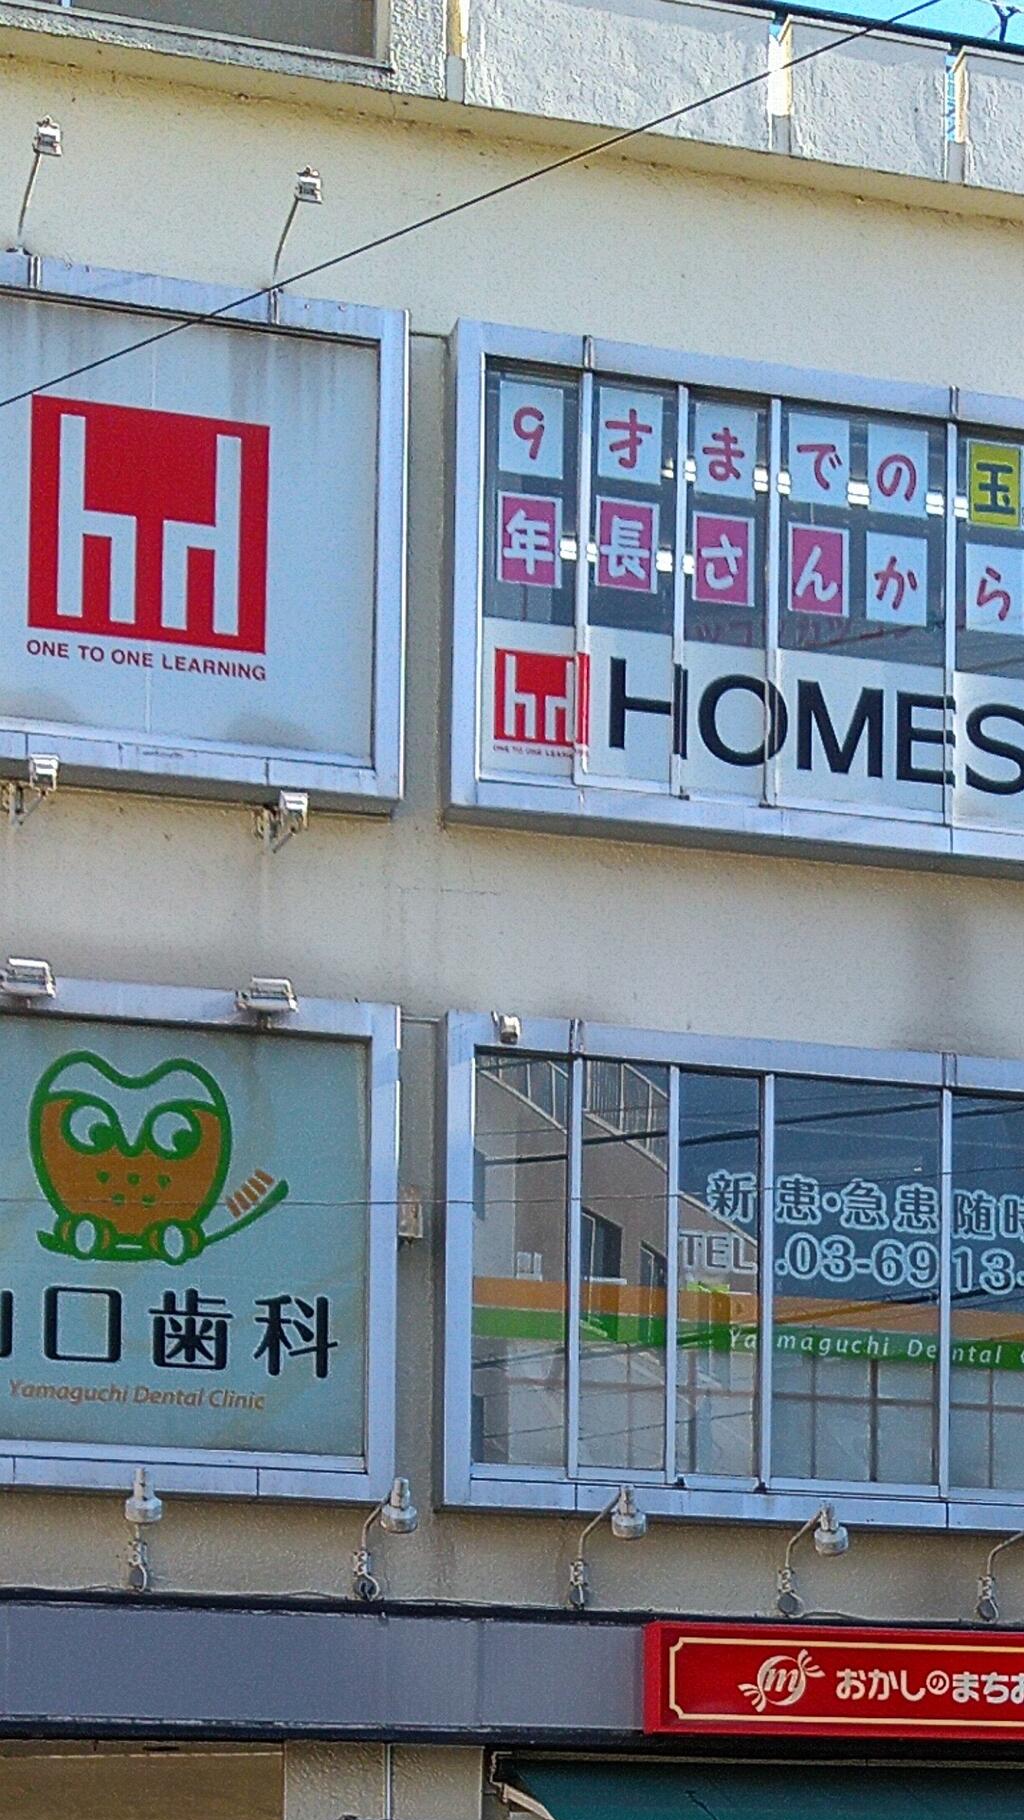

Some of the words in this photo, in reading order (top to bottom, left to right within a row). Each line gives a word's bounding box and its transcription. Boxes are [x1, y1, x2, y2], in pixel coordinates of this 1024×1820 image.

[26, 639, 70, 660] ONE
[78, 644, 104, 663] TO
[111, 648, 154, 668] ONE
[161, 653, 267, 682] LEARNING
[0, 1286, 338, 1379] 口歯科
[727, 1327, 889, 1358] Yamaguchi
[907, 1336, 1001, 1365] Dental
[8, 1378, 129, 1406] Yamaguchi
[133, 1384, 203, 1405] Dental
[208, 1387, 266, 1410] Clinic
